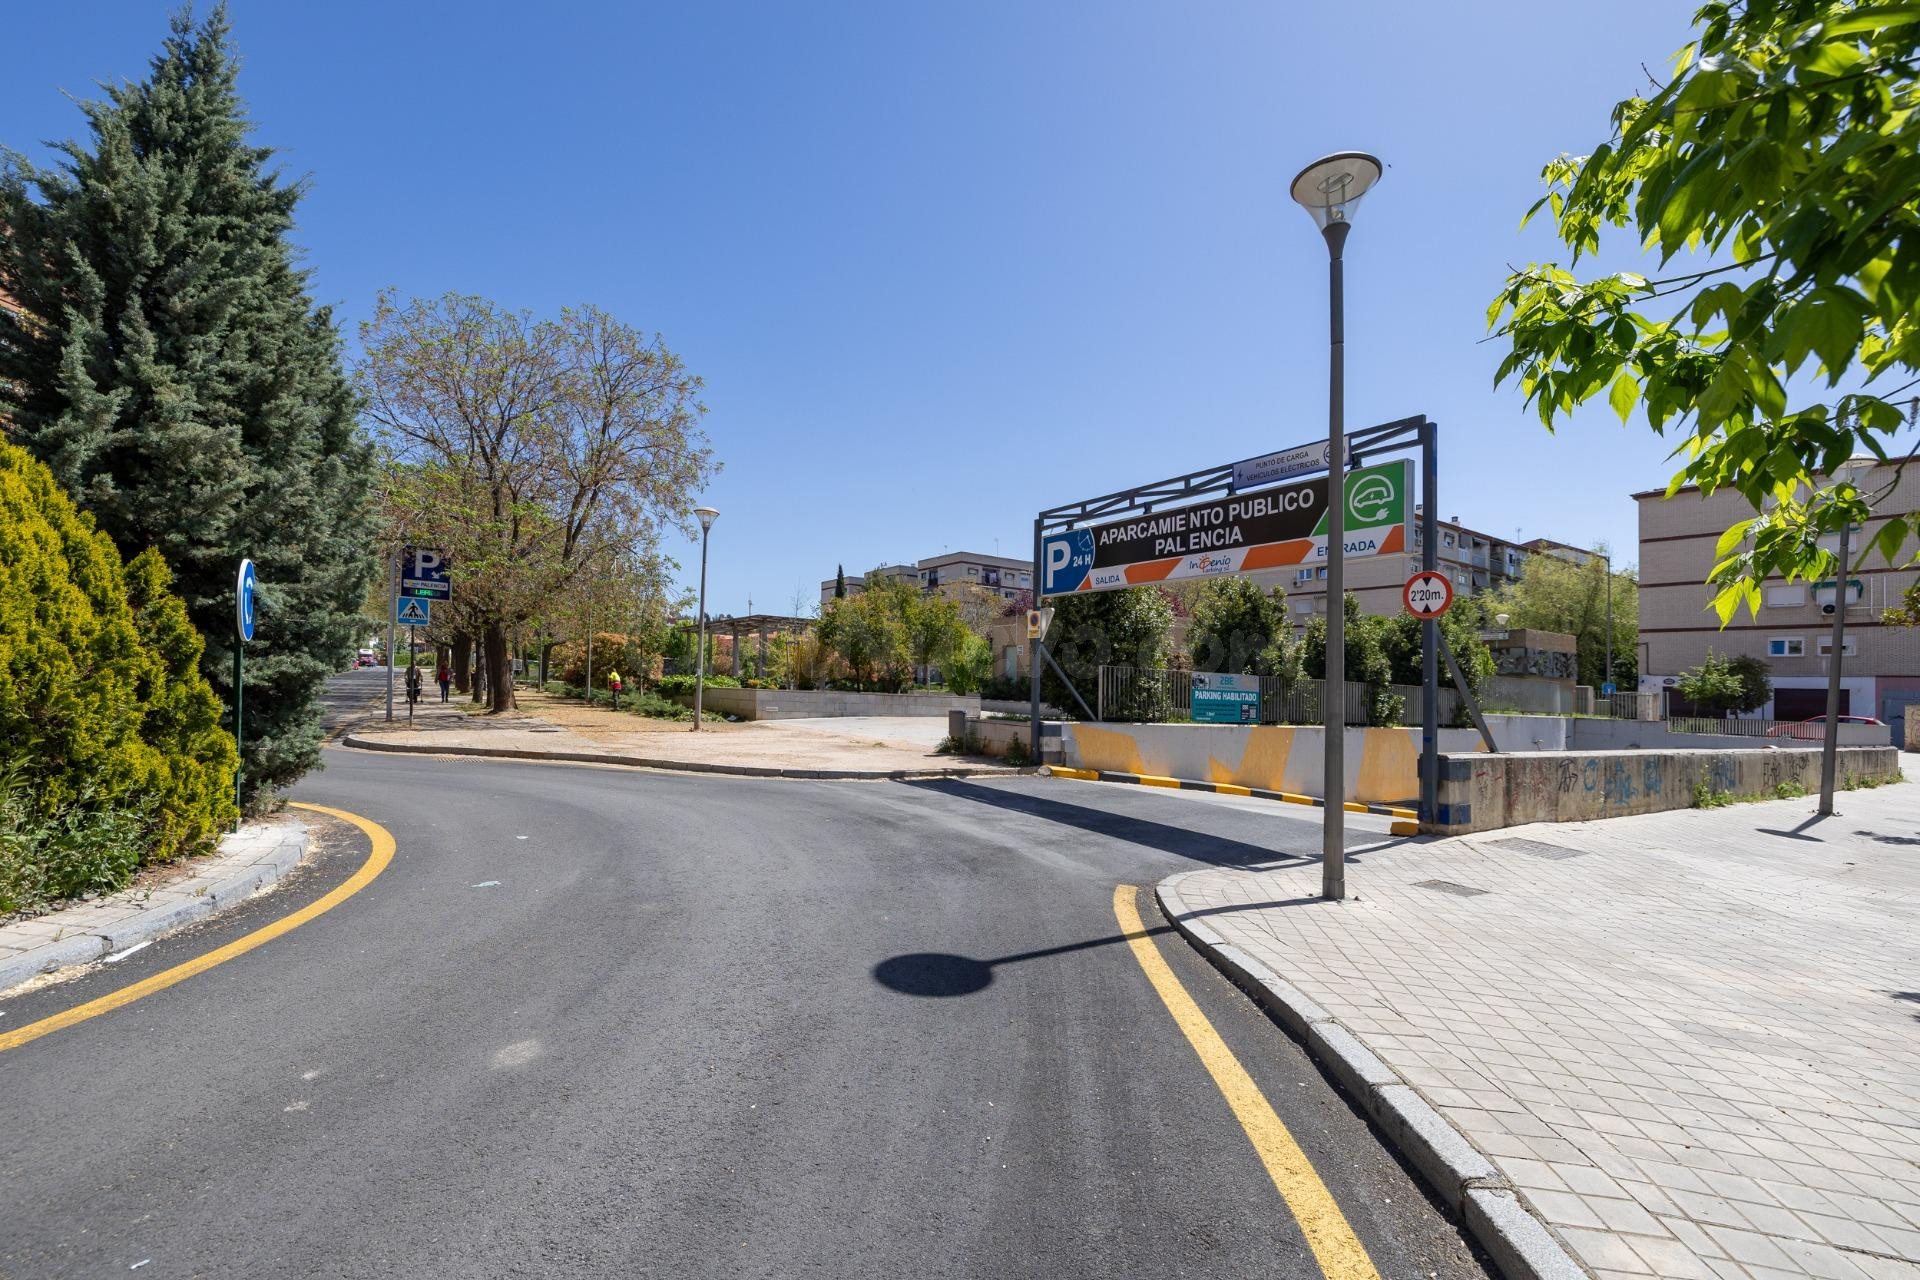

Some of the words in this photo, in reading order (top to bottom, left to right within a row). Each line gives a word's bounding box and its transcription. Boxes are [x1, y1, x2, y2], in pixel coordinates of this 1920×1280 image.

[1255, 458, 1276, 470] PUNTO
[1277, 456, 1286, 465] DE
[1286, 451, 1309, 462] CARGA
[1099, 506, 1224, 546] APARCAMIENTO
[1228, 487, 1314, 521] PUBLICO
[1155, 527, 1243, 555] PALENCIA
[1317, 540, 1376, 557] ERADA
[414, 549, 440, 578] P
[1046, 540, 1071, 588] P
[1072, 555, 1083, 567] 24
[1084, 554, 1091, 565] H
[420, 581, 446, 589] PALENCIA
[1095, 574, 1121, 585] SALIDA
[1220, 676, 1233, 685] ZBE
[1194, 690, 1221, 700] PARKING
[1223, 692, 1257, 702] HABILITADO
